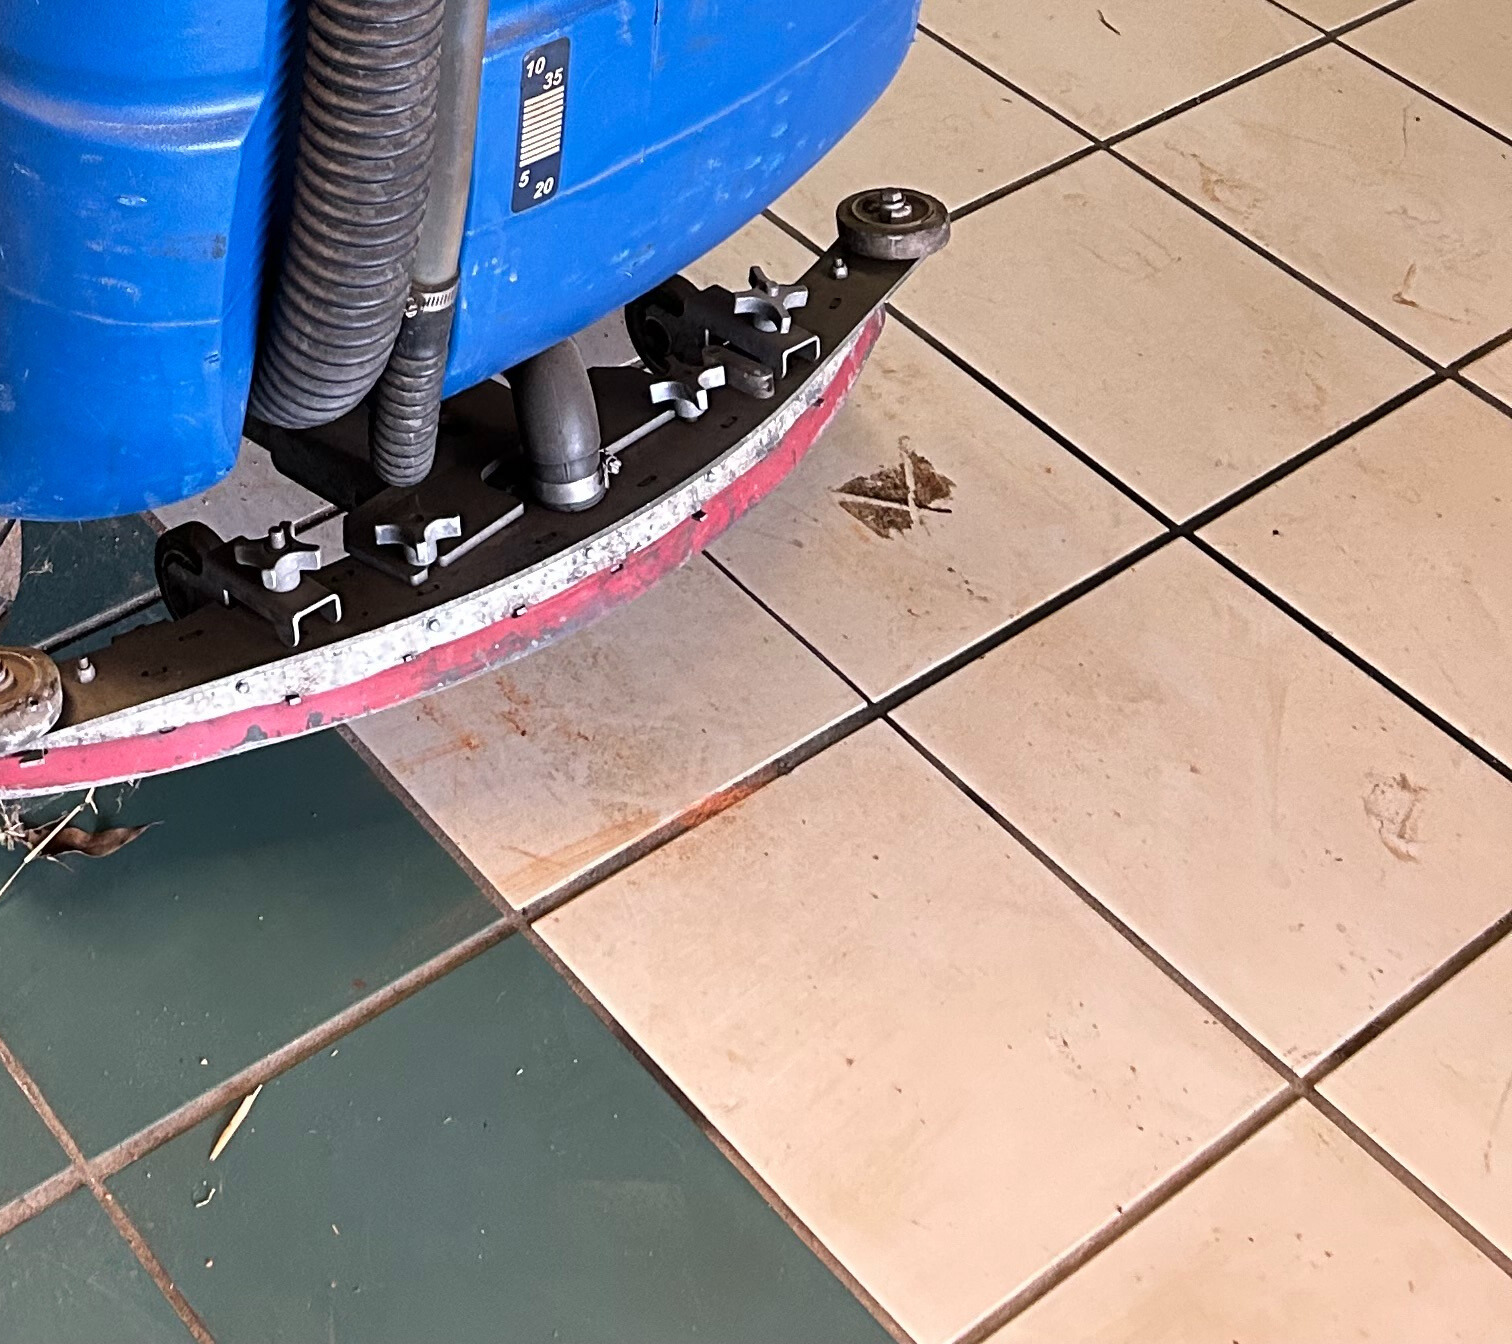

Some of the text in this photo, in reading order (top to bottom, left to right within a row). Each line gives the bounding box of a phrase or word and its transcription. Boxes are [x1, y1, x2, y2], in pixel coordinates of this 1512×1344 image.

[526, 56, 546, 79] 10
[542, 67, 564, 90] 35
[518, 169, 530, 188] 5
[533, 176, 555, 199] 20
